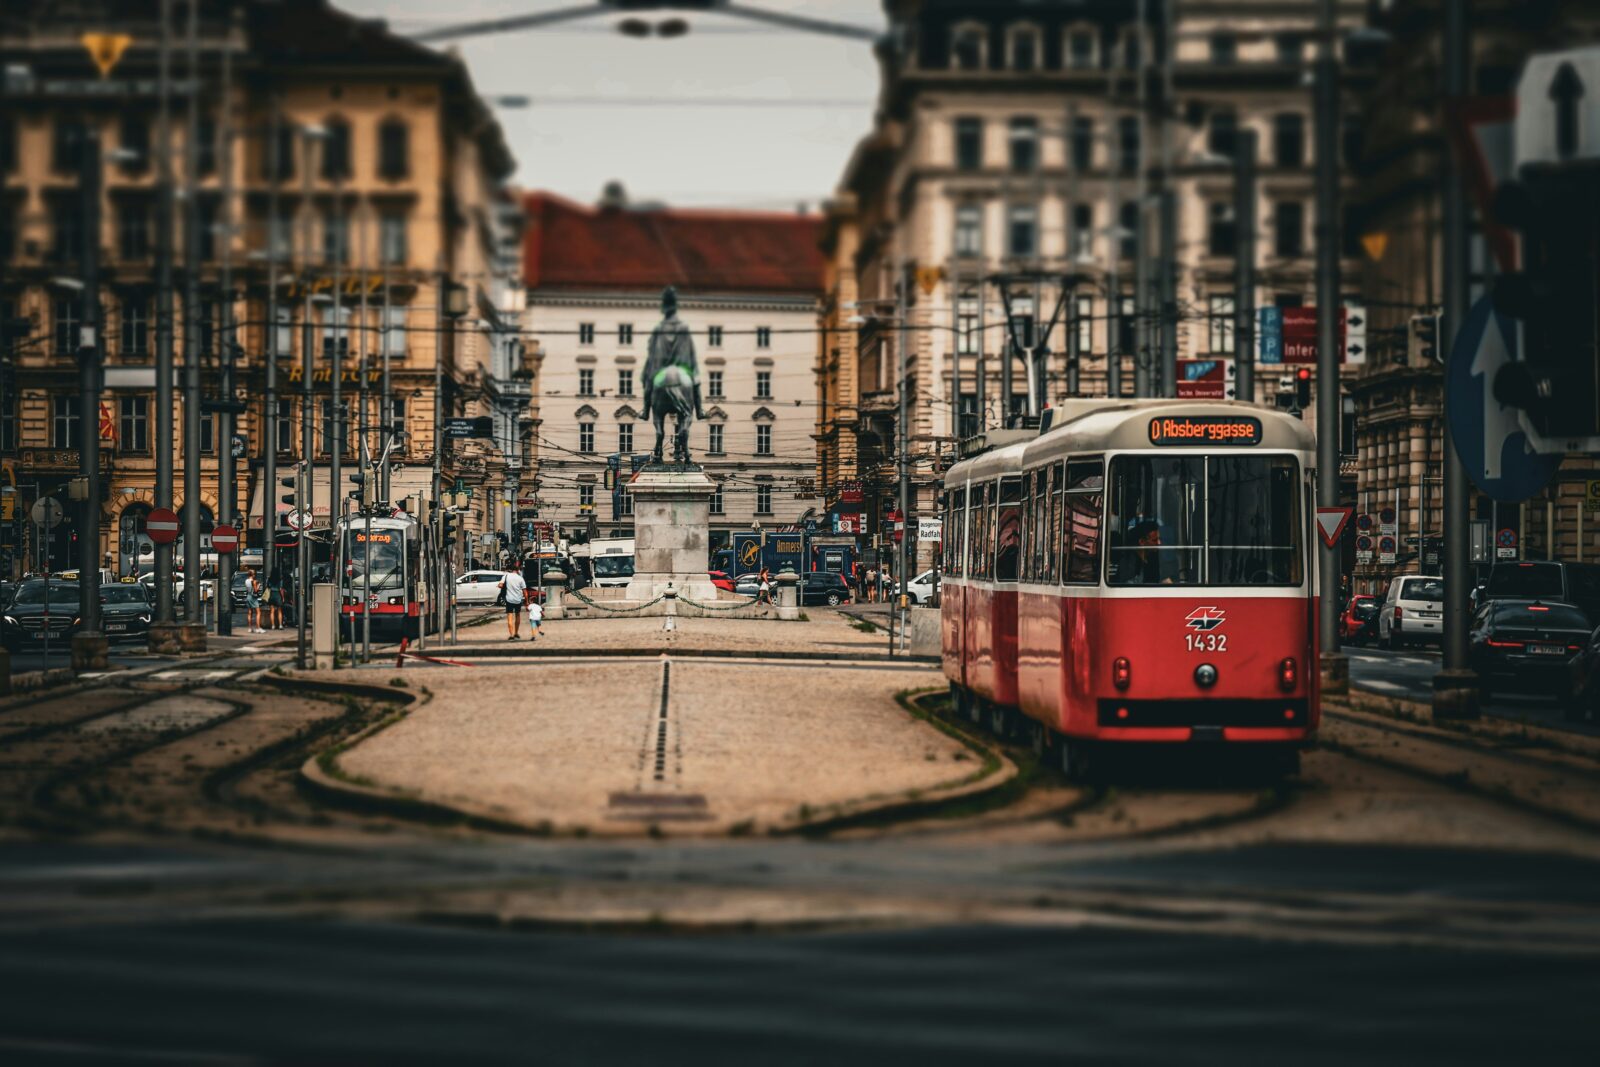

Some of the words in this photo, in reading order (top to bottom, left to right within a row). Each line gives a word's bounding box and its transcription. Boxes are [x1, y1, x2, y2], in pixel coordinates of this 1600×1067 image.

[1163, 419, 1254, 440] Absberggasse
[357, 533, 391, 544] Soderzug
[920, 530, 940, 538] Radfah
[1185, 634, 1227, 652] 1432
